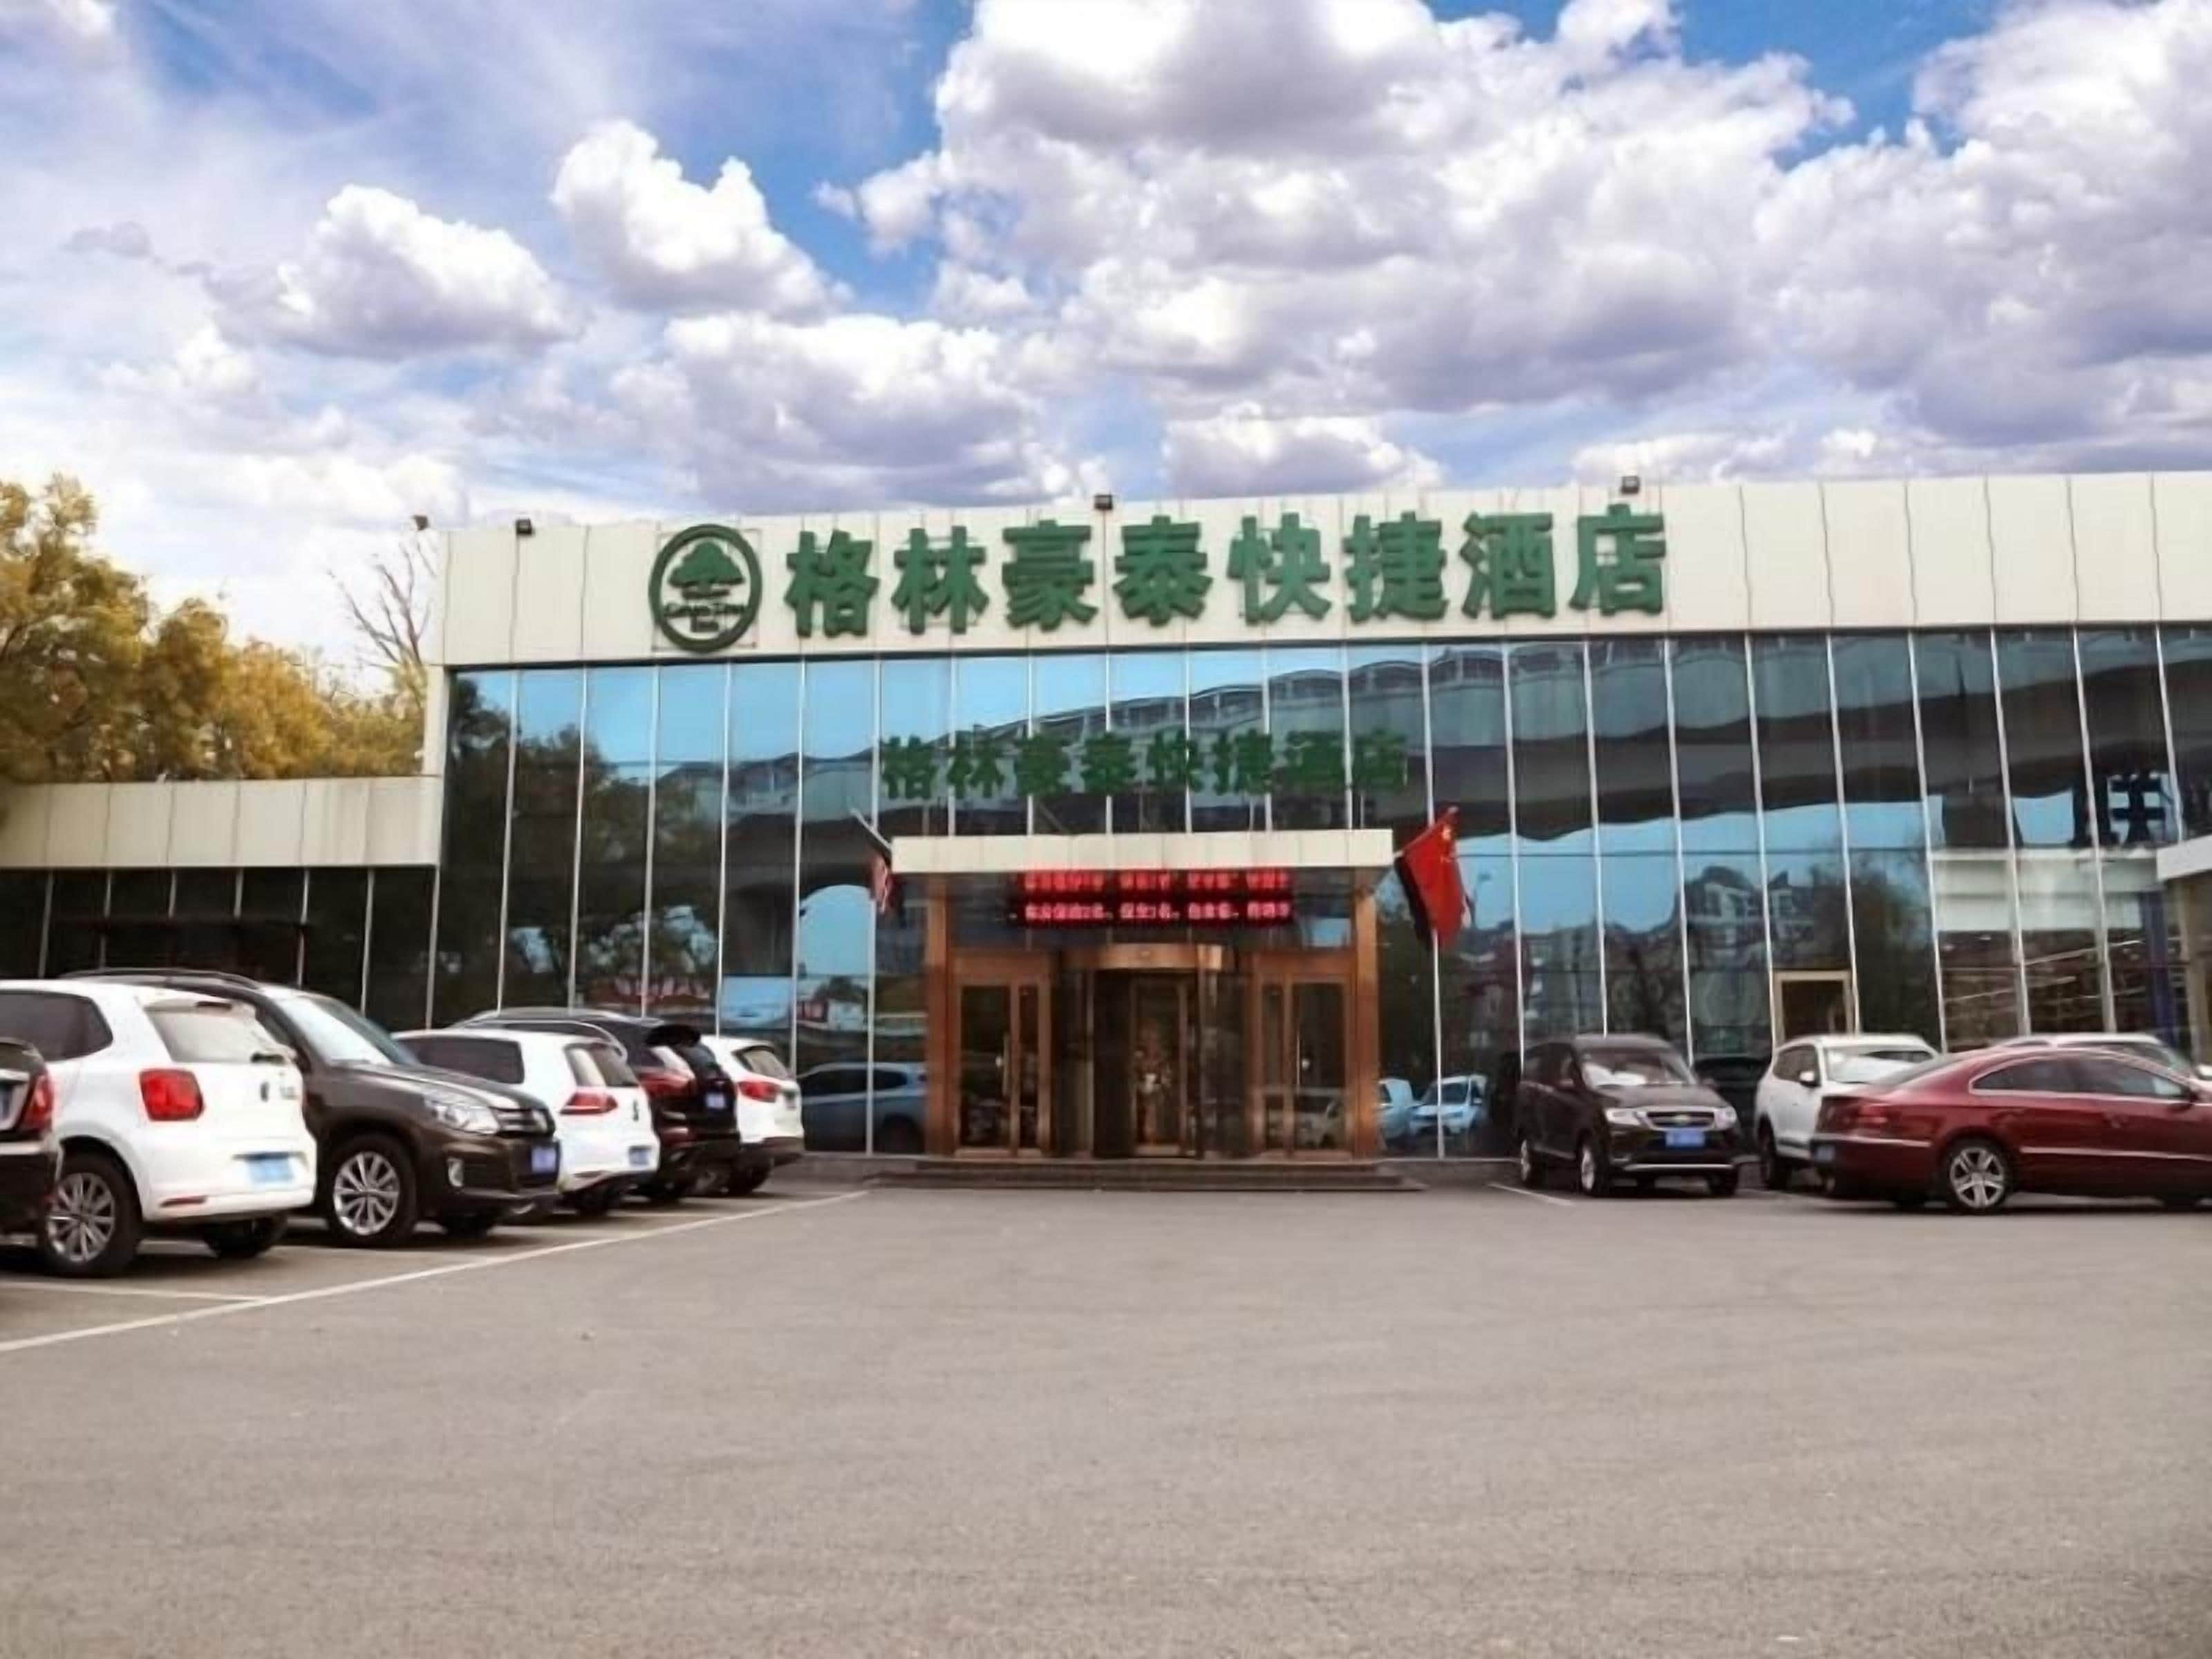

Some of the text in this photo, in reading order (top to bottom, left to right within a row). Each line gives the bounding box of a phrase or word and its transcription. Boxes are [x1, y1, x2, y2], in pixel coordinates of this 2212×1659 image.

[784, 504, 1667, 638] 格林豪泰快捷酒店
